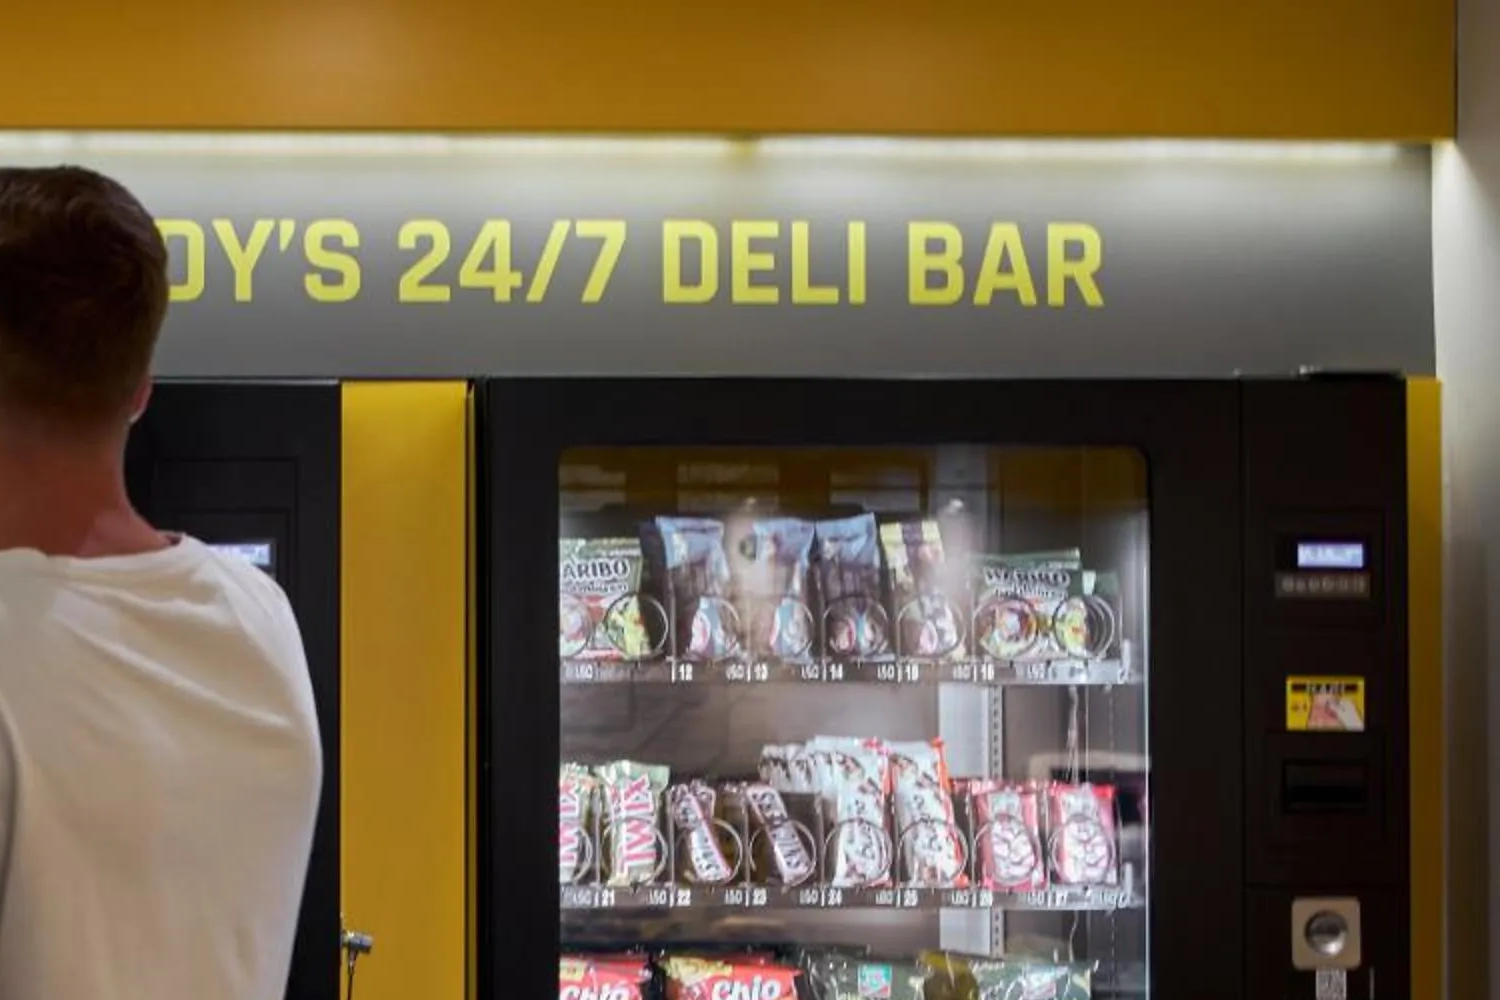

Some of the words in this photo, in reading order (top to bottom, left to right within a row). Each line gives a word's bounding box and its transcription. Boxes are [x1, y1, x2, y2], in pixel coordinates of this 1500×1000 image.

[397, 222, 622, 306] 24/7
[661, 222, 868, 307] DELI
[906, 224, 1106, 308] BAR
